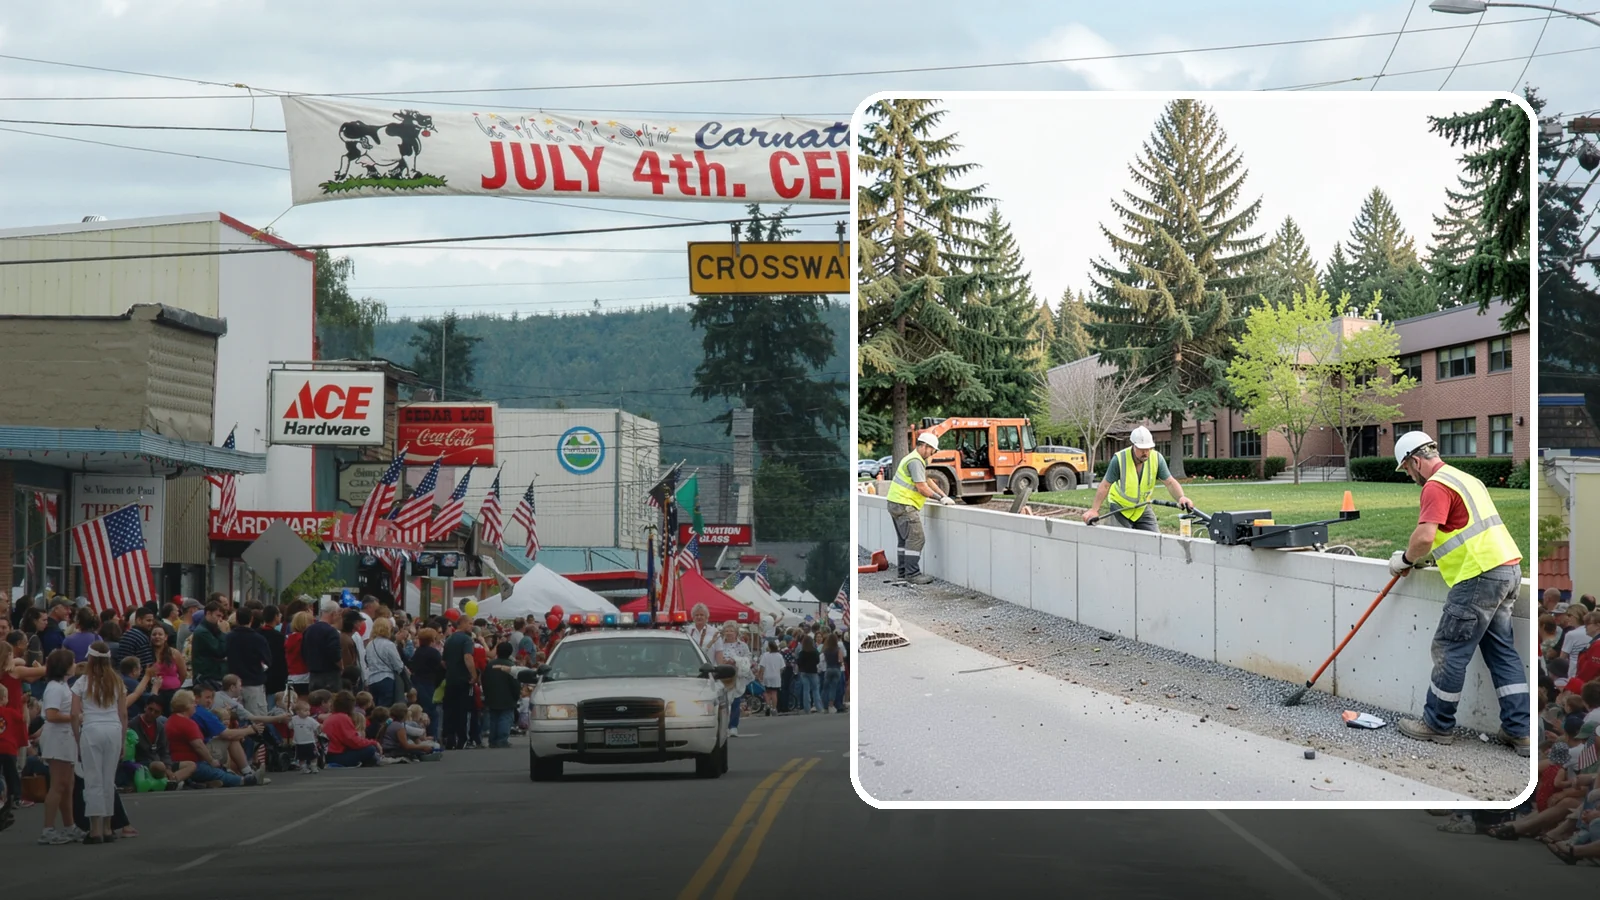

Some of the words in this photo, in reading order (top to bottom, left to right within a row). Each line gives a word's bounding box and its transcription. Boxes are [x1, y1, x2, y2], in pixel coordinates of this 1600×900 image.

[481, 141, 604, 192] JULY
[632, 150, 746, 197] 4th.
[282, 380, 374, 420] ACE
[405, 409, 452, 422] CEDAR
[283, 421, 371, 436] Hardware
[95, 485, 124, 495] Vincent
[126, 485, 136, 495] de
[137, 485, 155, 495] Paul
[688, 526, 741, 535] CRNATION
[699, 535, 730, 544] GLASS
